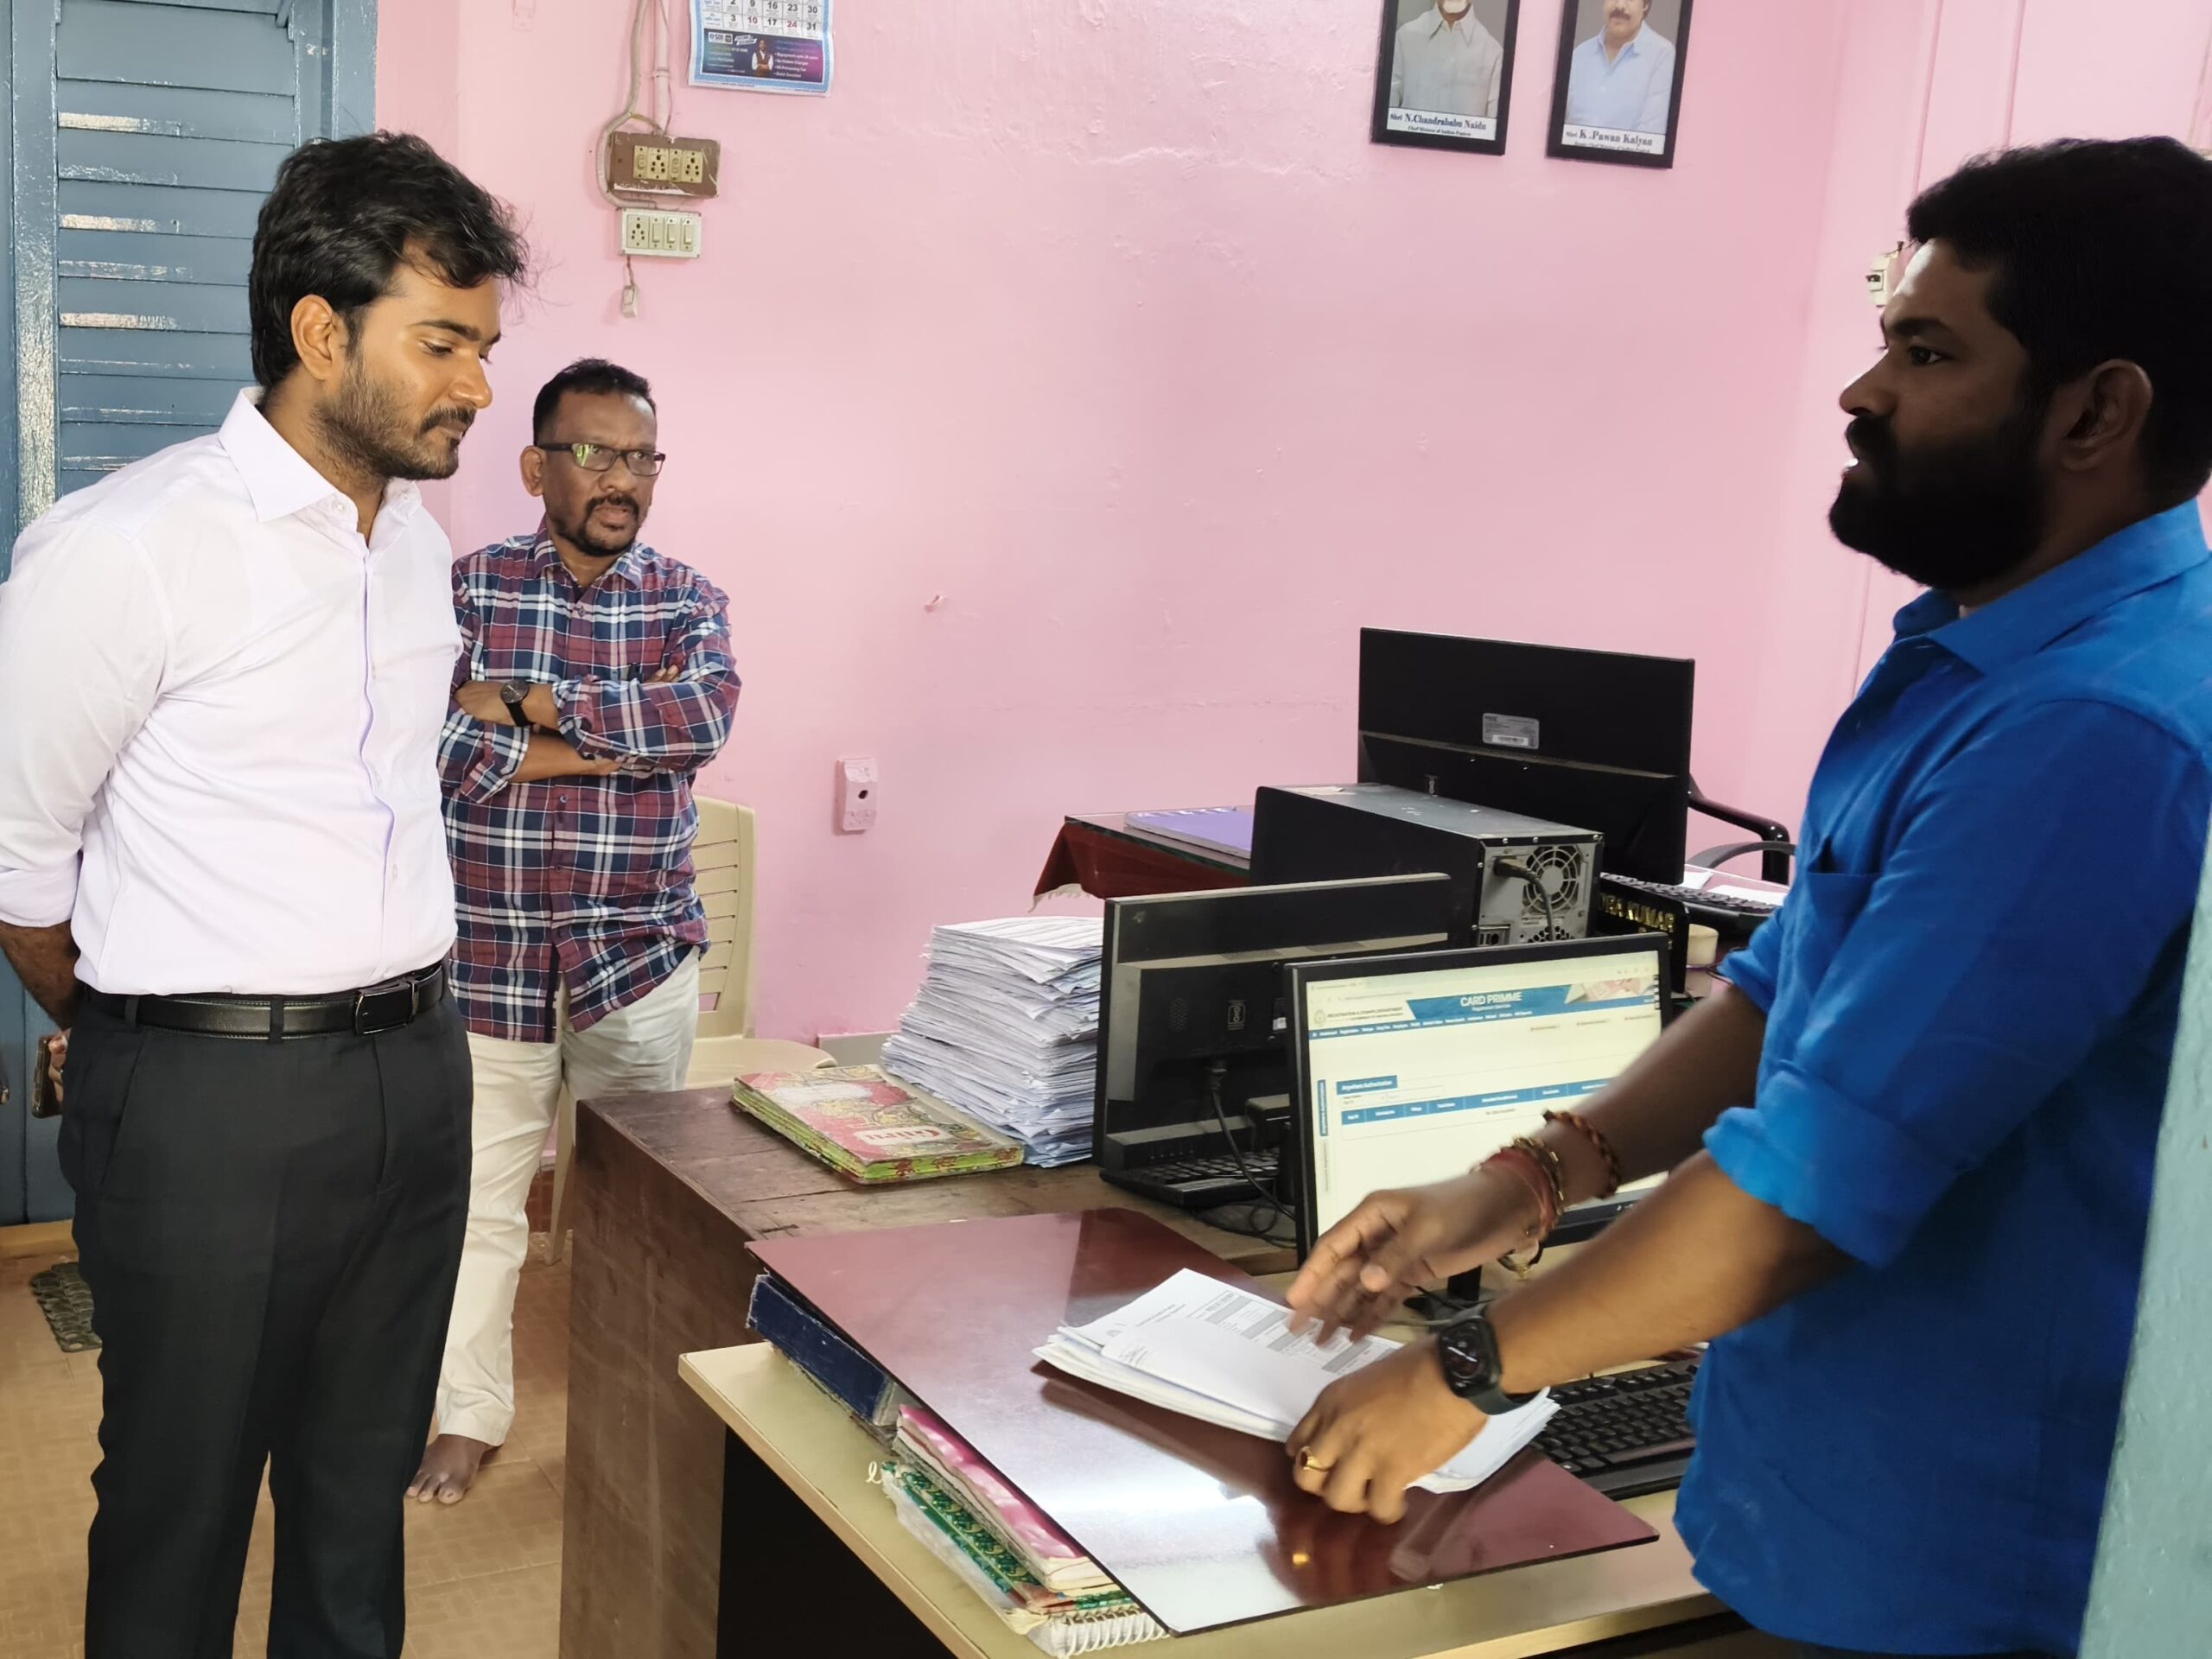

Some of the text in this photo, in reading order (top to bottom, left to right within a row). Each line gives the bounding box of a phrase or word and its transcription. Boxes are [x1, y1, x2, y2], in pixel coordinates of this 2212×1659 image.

[787, 3, 798, 12] 23
[787, 20, 798, 29] 24
[806, 22, 817, 31] 31
[1405, 113, 1463, 128] N.Chandrababu
[1464, 119, 1487, 130] Naidu
[1623, 133, 1653, 147] Kalyan
[1459, 991, 1522, 1007] CARD PRIMME
